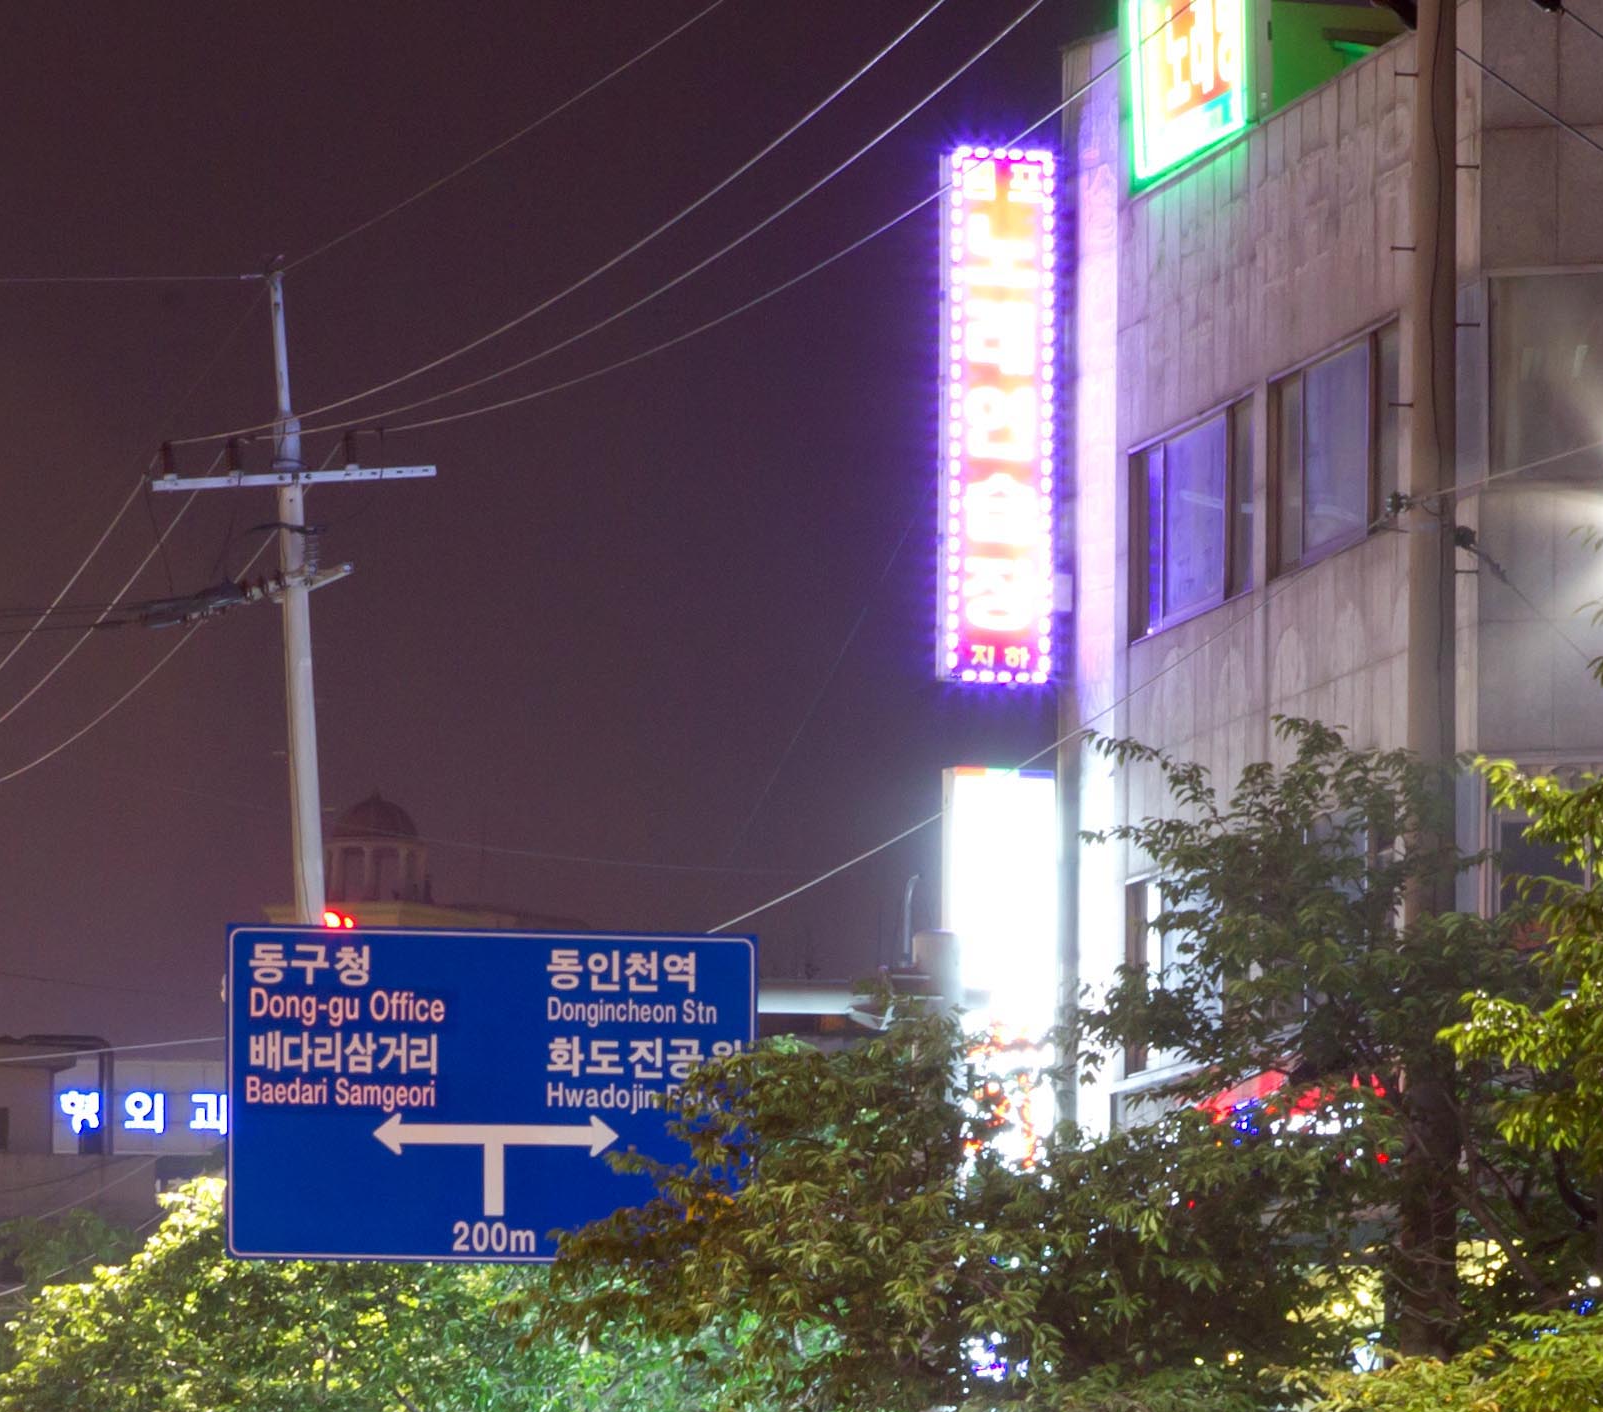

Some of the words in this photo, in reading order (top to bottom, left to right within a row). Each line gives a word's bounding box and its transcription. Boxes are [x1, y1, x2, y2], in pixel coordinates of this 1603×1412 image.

[970, 644, 1031, 669] 지하
[249, 944, 371, 986] 동구청
[547, 950, 696, 992] 동인천역
[250, 988, 361, 1027] Dong-gu
[370, 990, 445, 1023] Office
[548, 996, 677, 1028] Dongincheon
[682, 1000, 718, 1025] Stn
[249, 1031, 439, 1075] 배다리삼거리
[246, 1076, 328, 1106] Baedari
[334, 1080, 436, 1110] Samgeori
[547, 1082, 661, 1115] Hwadojin
[452, 1221, 536, 1253] 200m
